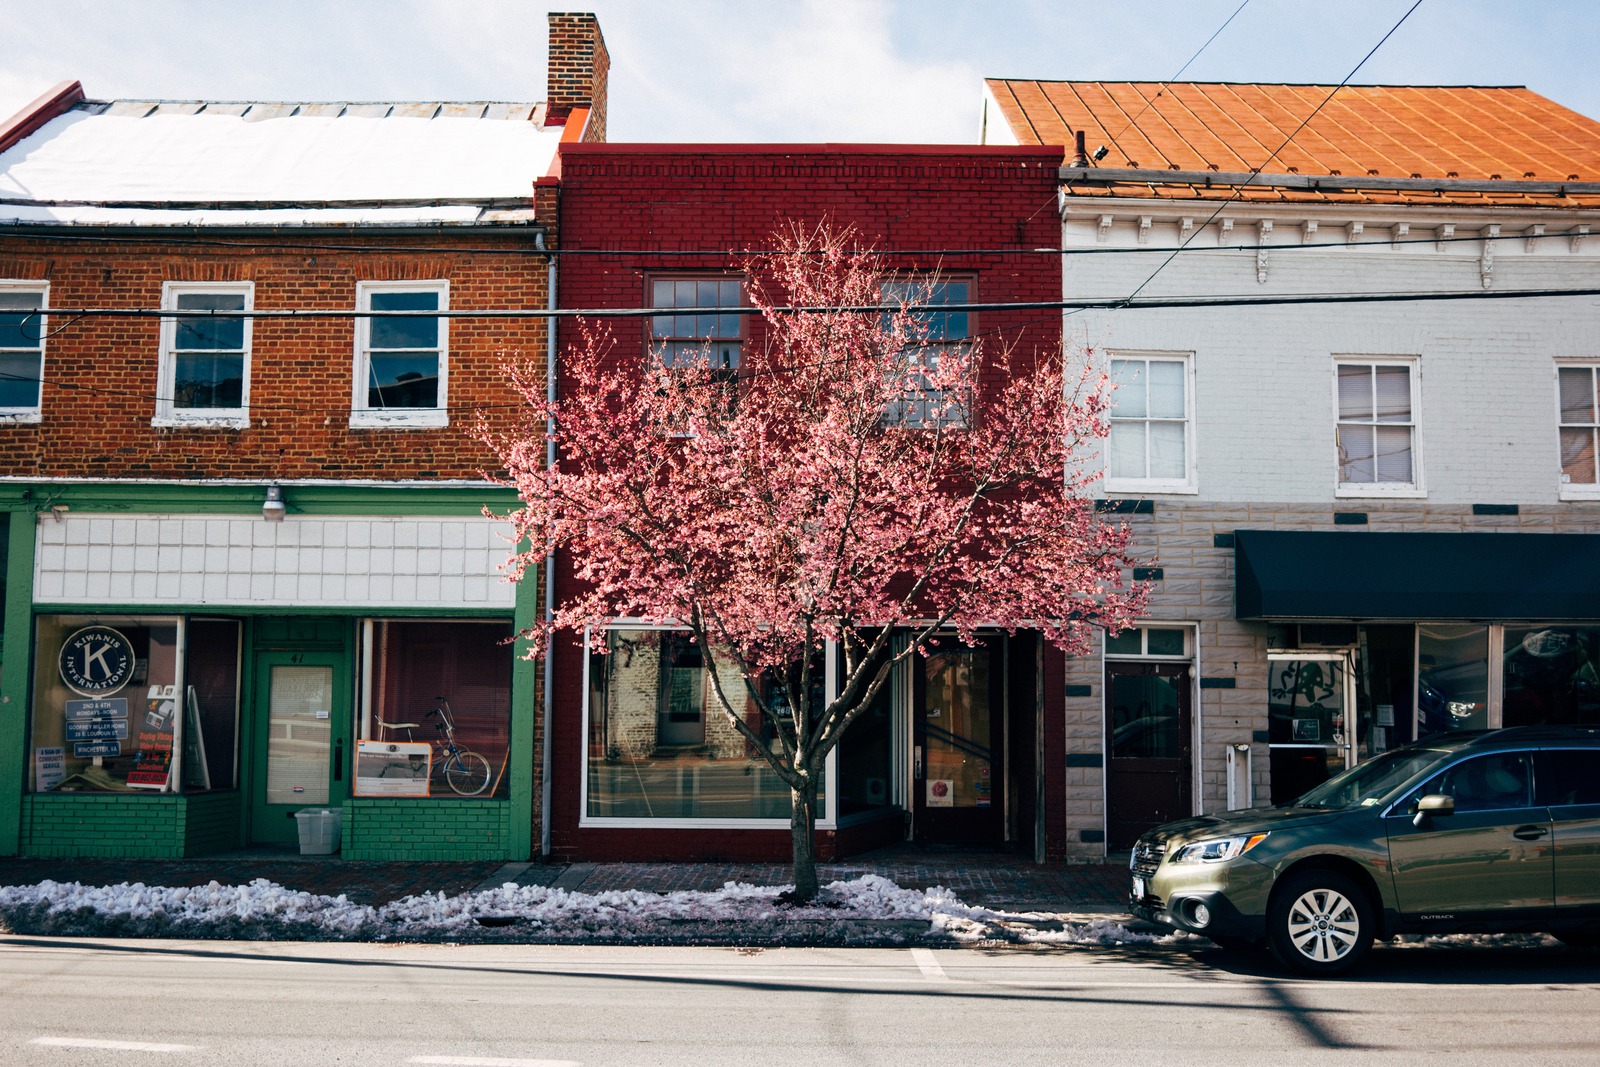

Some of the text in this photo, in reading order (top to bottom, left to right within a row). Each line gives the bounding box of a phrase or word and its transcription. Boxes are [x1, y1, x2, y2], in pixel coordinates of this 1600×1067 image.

[74, 634, 121, 649] KIWANIS
[83, 642, 113, 681] K
[291, 653, 304, 664] 41
[67, 654, 127, 689] INTERNATIONAL
[158, 732, 172, 742] Vintag
